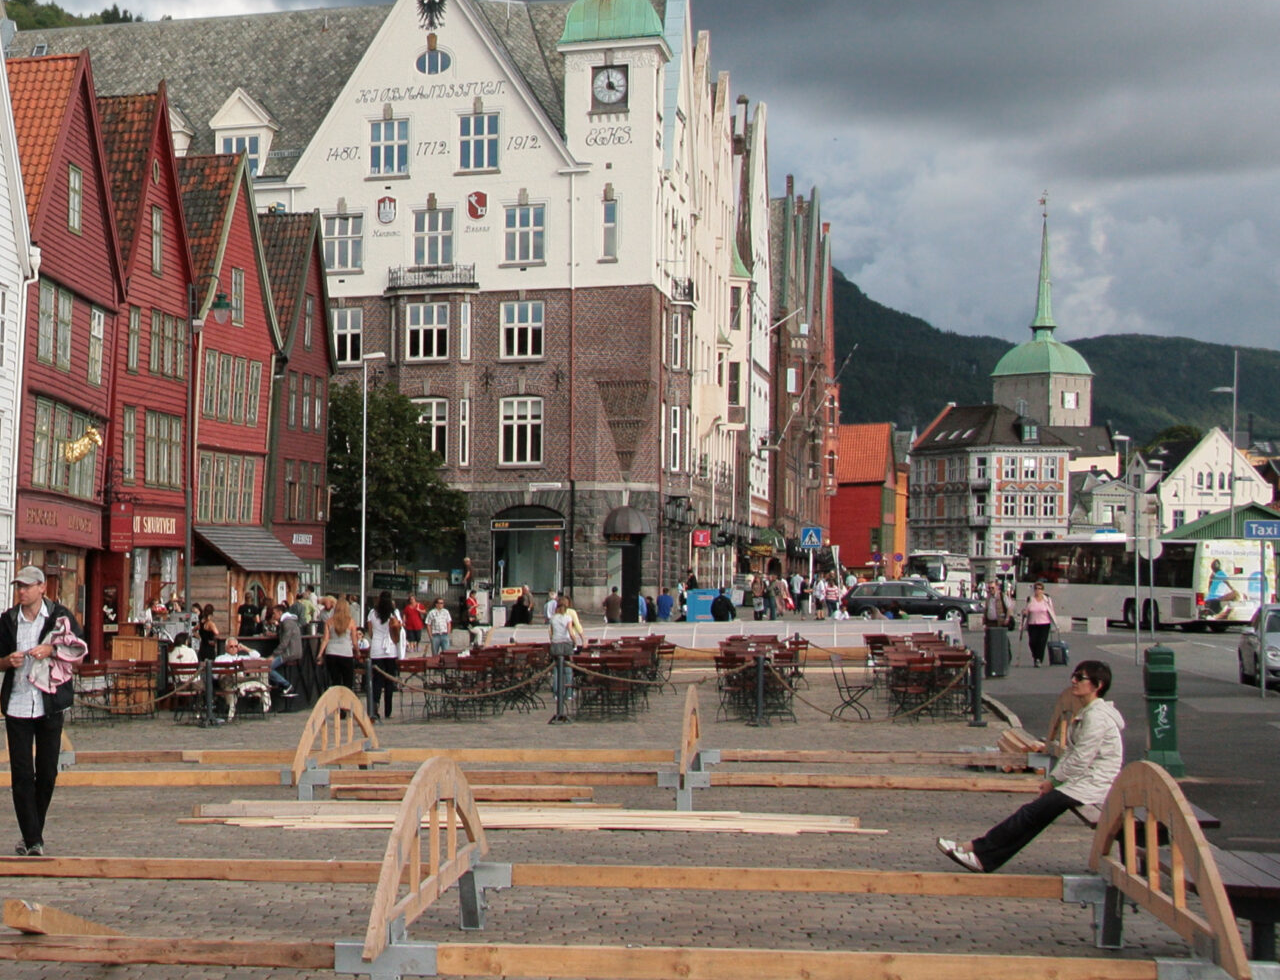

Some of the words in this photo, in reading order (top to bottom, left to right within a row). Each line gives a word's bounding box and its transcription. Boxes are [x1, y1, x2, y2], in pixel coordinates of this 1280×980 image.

[416, 141, 451, 157] 1712.
[506, 135, 542, 151] 1912.
[1250, 523, 1278, 536] Taxi
